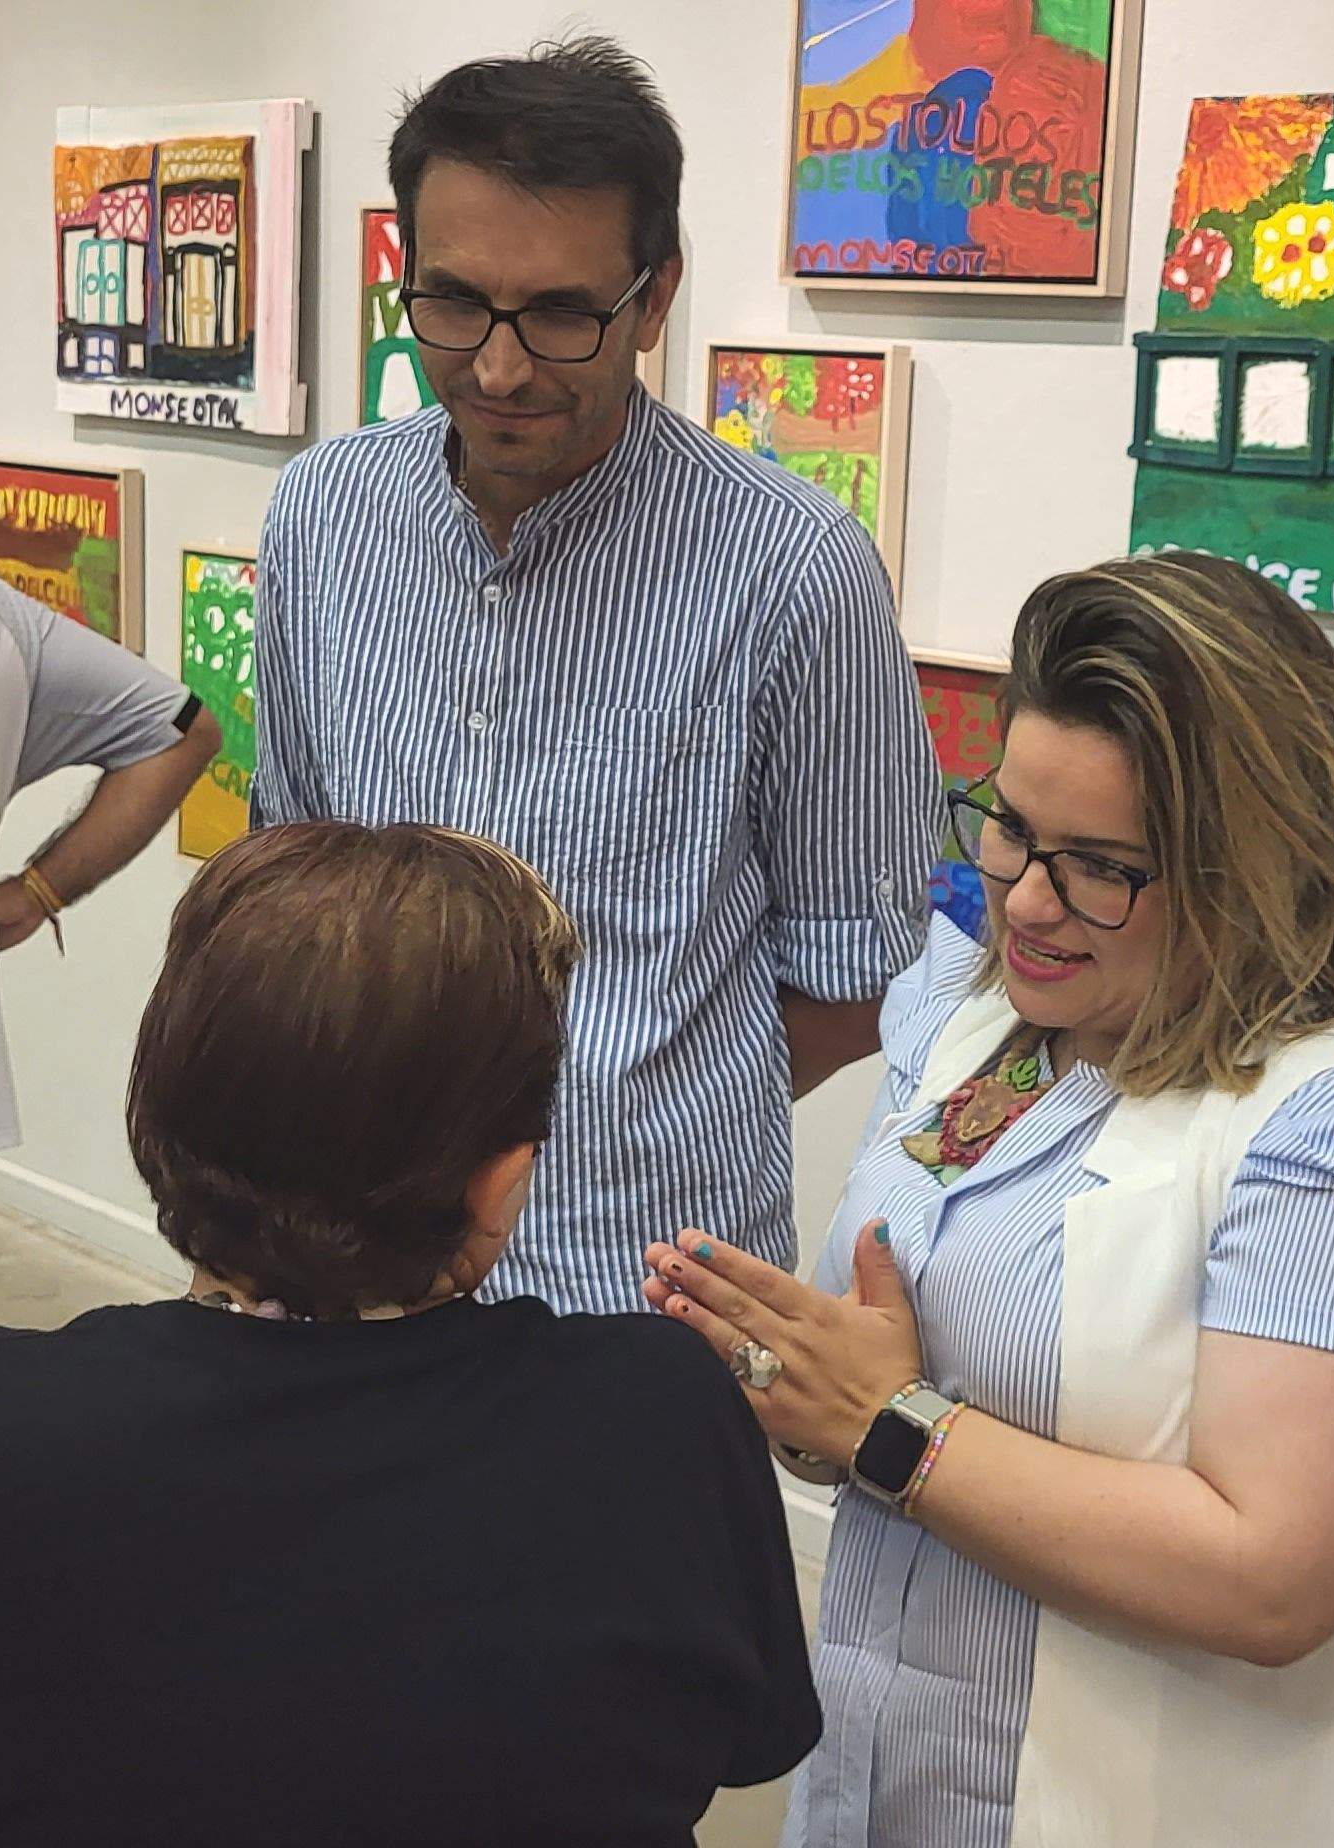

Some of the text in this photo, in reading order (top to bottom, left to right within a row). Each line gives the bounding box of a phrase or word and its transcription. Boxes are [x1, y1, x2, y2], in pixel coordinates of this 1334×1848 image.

[805, 92, 1068, 160] LOS TOLDOS
[797, 152, 1102, 231] DE LOS HOTELES
[110, 389, 244, 429] MONSE OTAL
